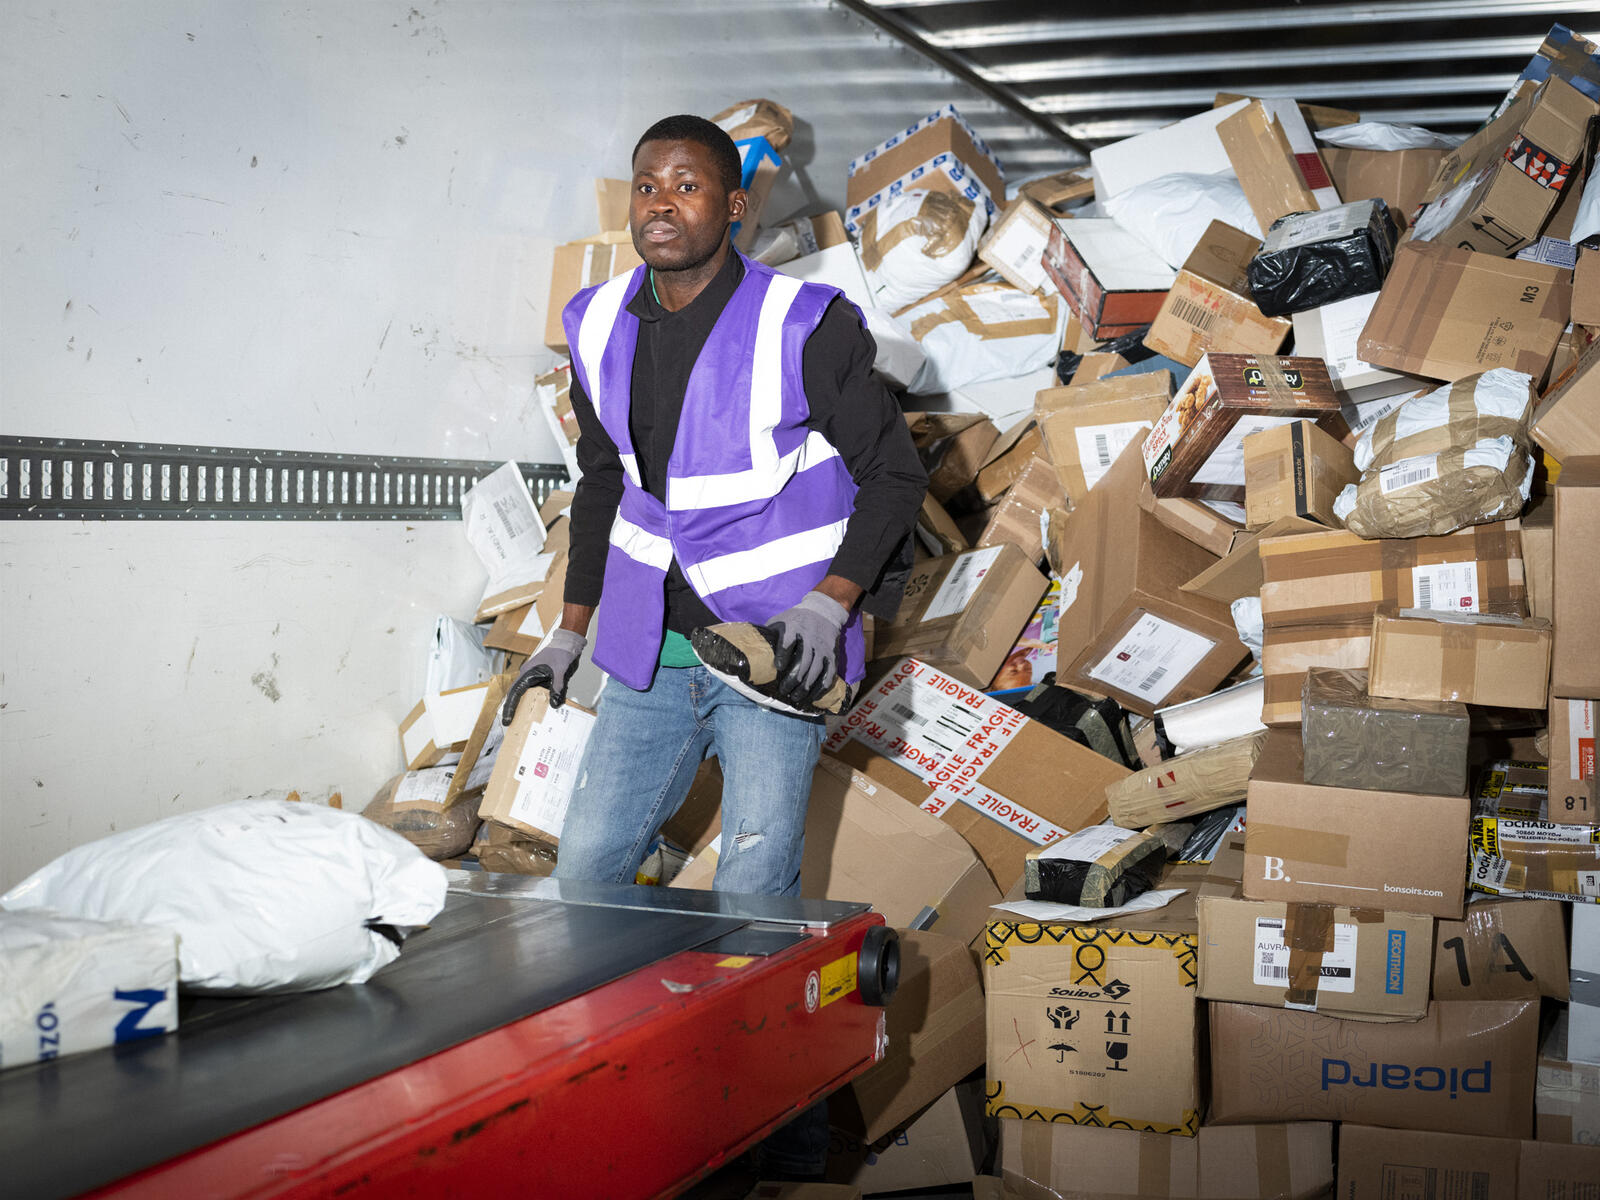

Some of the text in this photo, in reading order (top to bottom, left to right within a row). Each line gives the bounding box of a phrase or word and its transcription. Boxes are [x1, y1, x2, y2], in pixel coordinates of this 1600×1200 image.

[1520, 284, 1541, 304] M3
[926, 673, 987, 710] FRAGILE
[826, 699, 879, 750] FRAGILE
[945, 741, 999, 794] FRAGILE
[977, 793, 1041, 834] FRAGILE
[1501, 819, 1557, 830] OCHARD
[1262, 855, 1292, 883] B.
[1383, 883, 1444, 898] bonsoirs.com
[1321, 1059, 1493, 1100] picard
